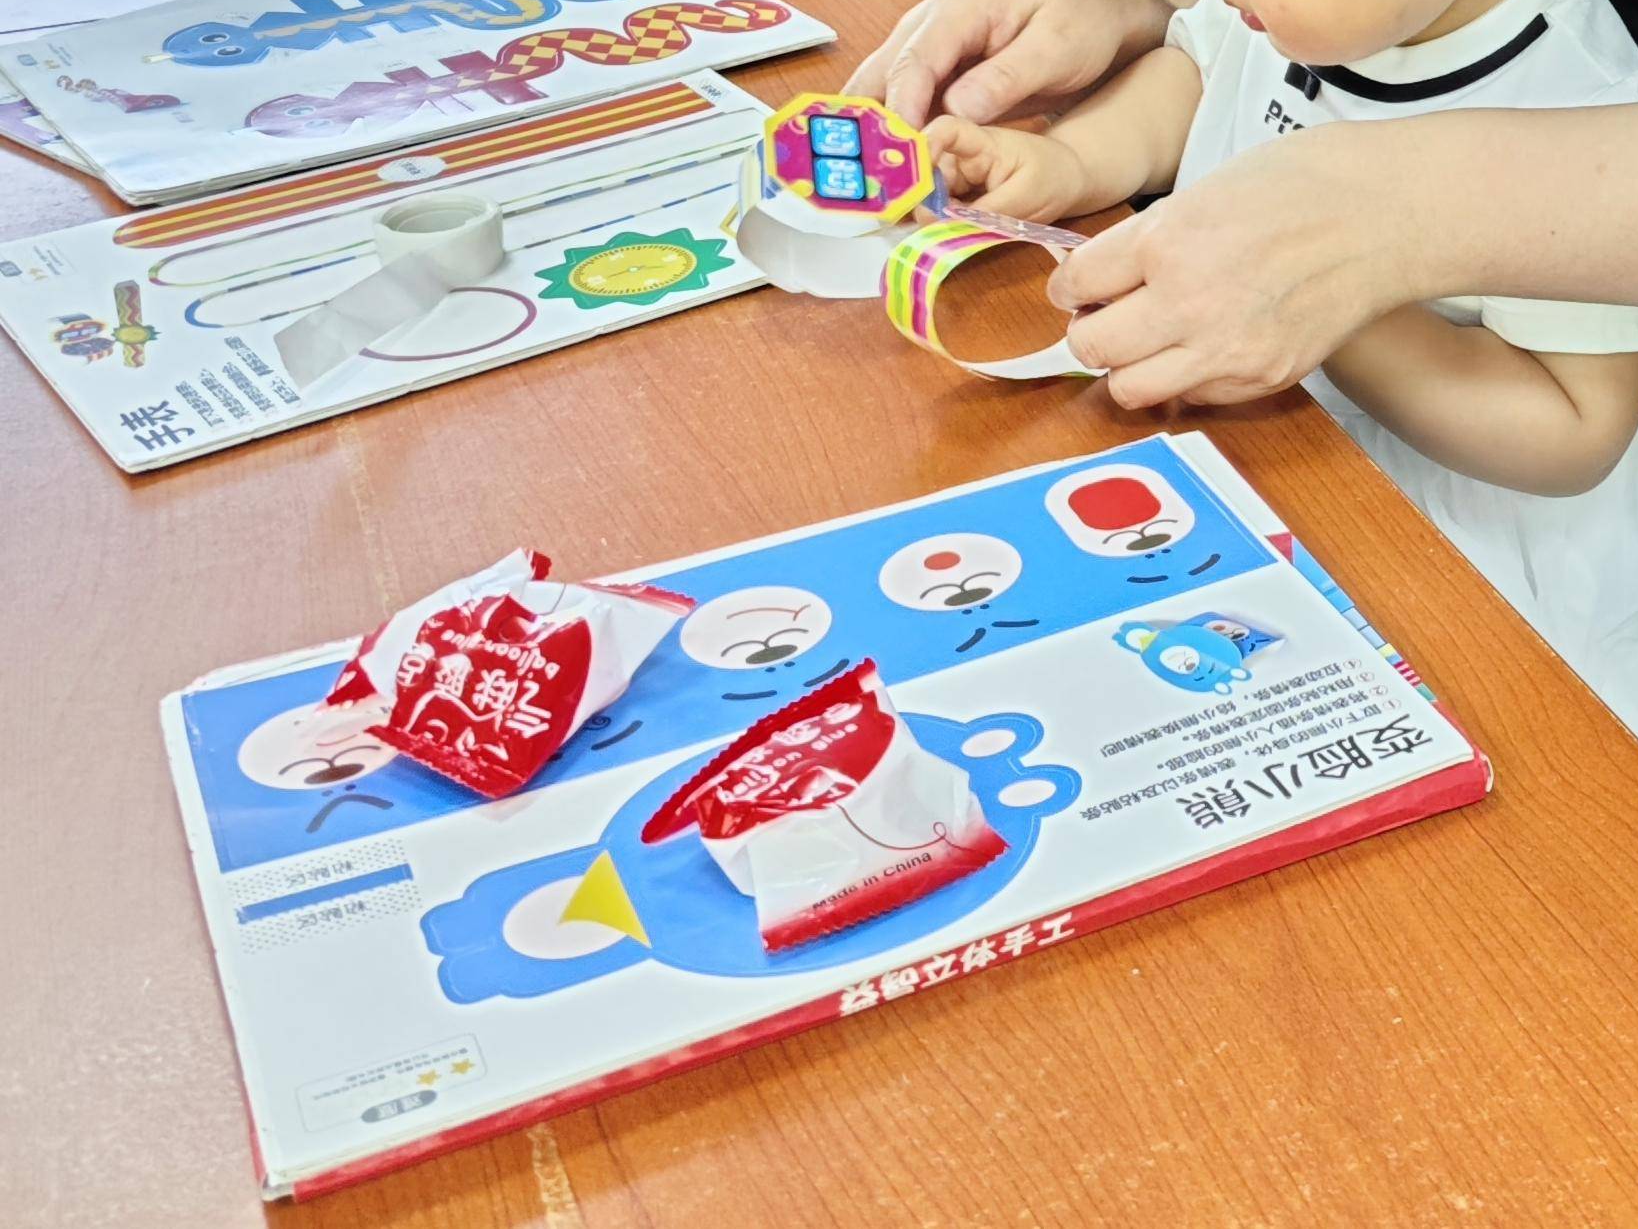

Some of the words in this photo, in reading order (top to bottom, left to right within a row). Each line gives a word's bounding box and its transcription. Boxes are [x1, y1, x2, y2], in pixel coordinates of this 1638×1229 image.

[1175, 714, 1433, 829] 变脸小熊
[883, 850, 933, 879] China
